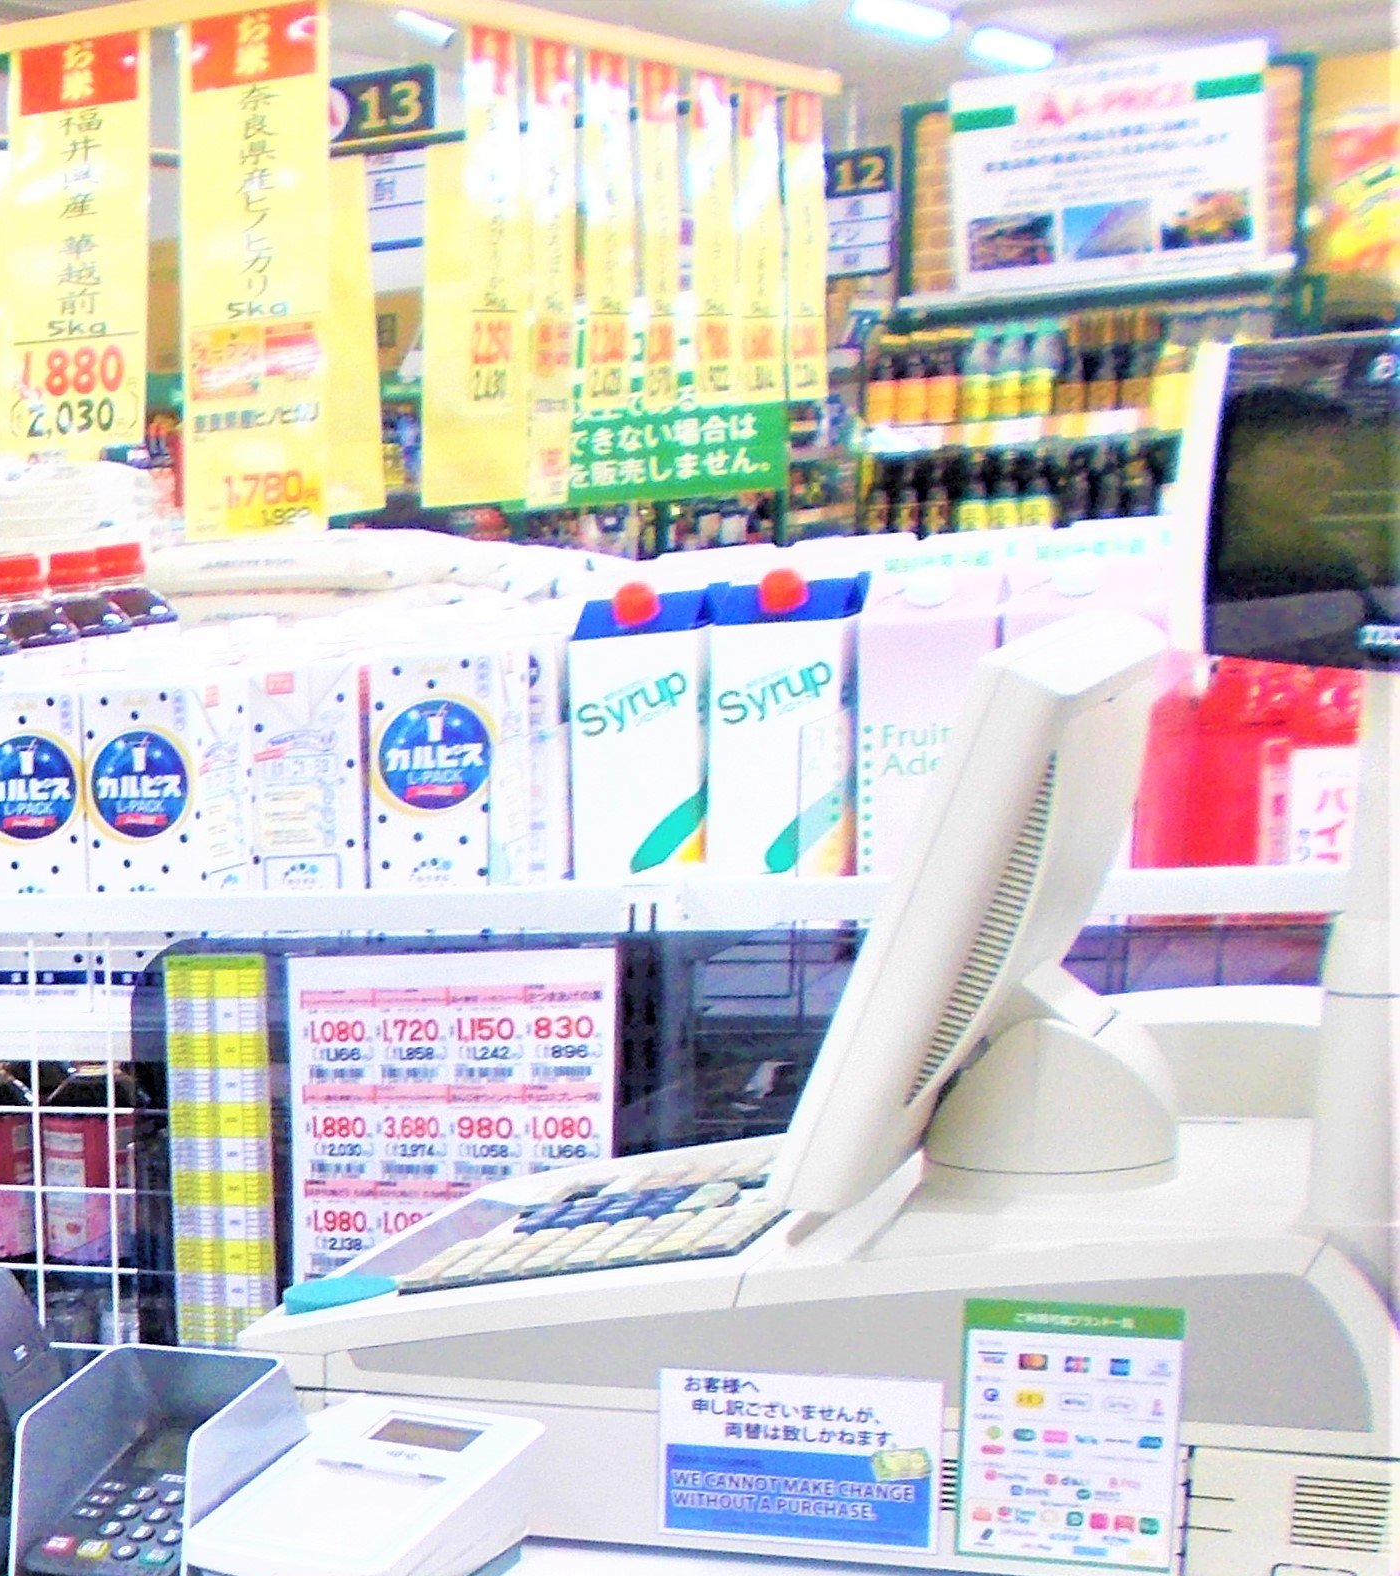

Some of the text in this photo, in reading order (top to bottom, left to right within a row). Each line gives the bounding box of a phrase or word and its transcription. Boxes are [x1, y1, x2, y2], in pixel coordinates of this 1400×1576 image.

[234, 11, 272, 77] お米
[60, 41, 96, 102] お米
[358, 80, 423, 130] 13
[835, 155, 886, 191] 12
[236, 84, 279, 297] 奈良県産ヒノヒカリ
[47, 319, 108, 337] 5kg
[27, 397, 116, 439] 2,030
[571, 412, 758, 456] できない場合は
[577, 671, 687, 737] Syrup
[717, 661, 832, 725] Syrup
[385, 742, 484, 773] カルピス
[98, 774, 183, 800] カルピス
[310, 1020, 366, 1044] 1,080
[382, 1018, 439, 1043] 1,720
[456, 1016, 515, 1042] 1,150
[534, 1015, 595, 1040] 830
[312, 1115, 366, 1140] 1,880
[383, 1115, 440, 1140] 3,680
[457, 1115, 514, 1140] 980
[532, 1115, 592, 1141] 1,080
[313, 1209, 368, 1234] 1,980
[684, 1376, 760, 1393] お客様へ
[692, 1398, 882, 1425] 申し訳ございませんが、
[725, 1421, 899, 1449] 両替は致しかねます。
[673, 1470, 914, 1502] WE CANNOT MAKE CHANGE
[673, 1491, 878, 1522] WITHOUT A PURCHASE.
